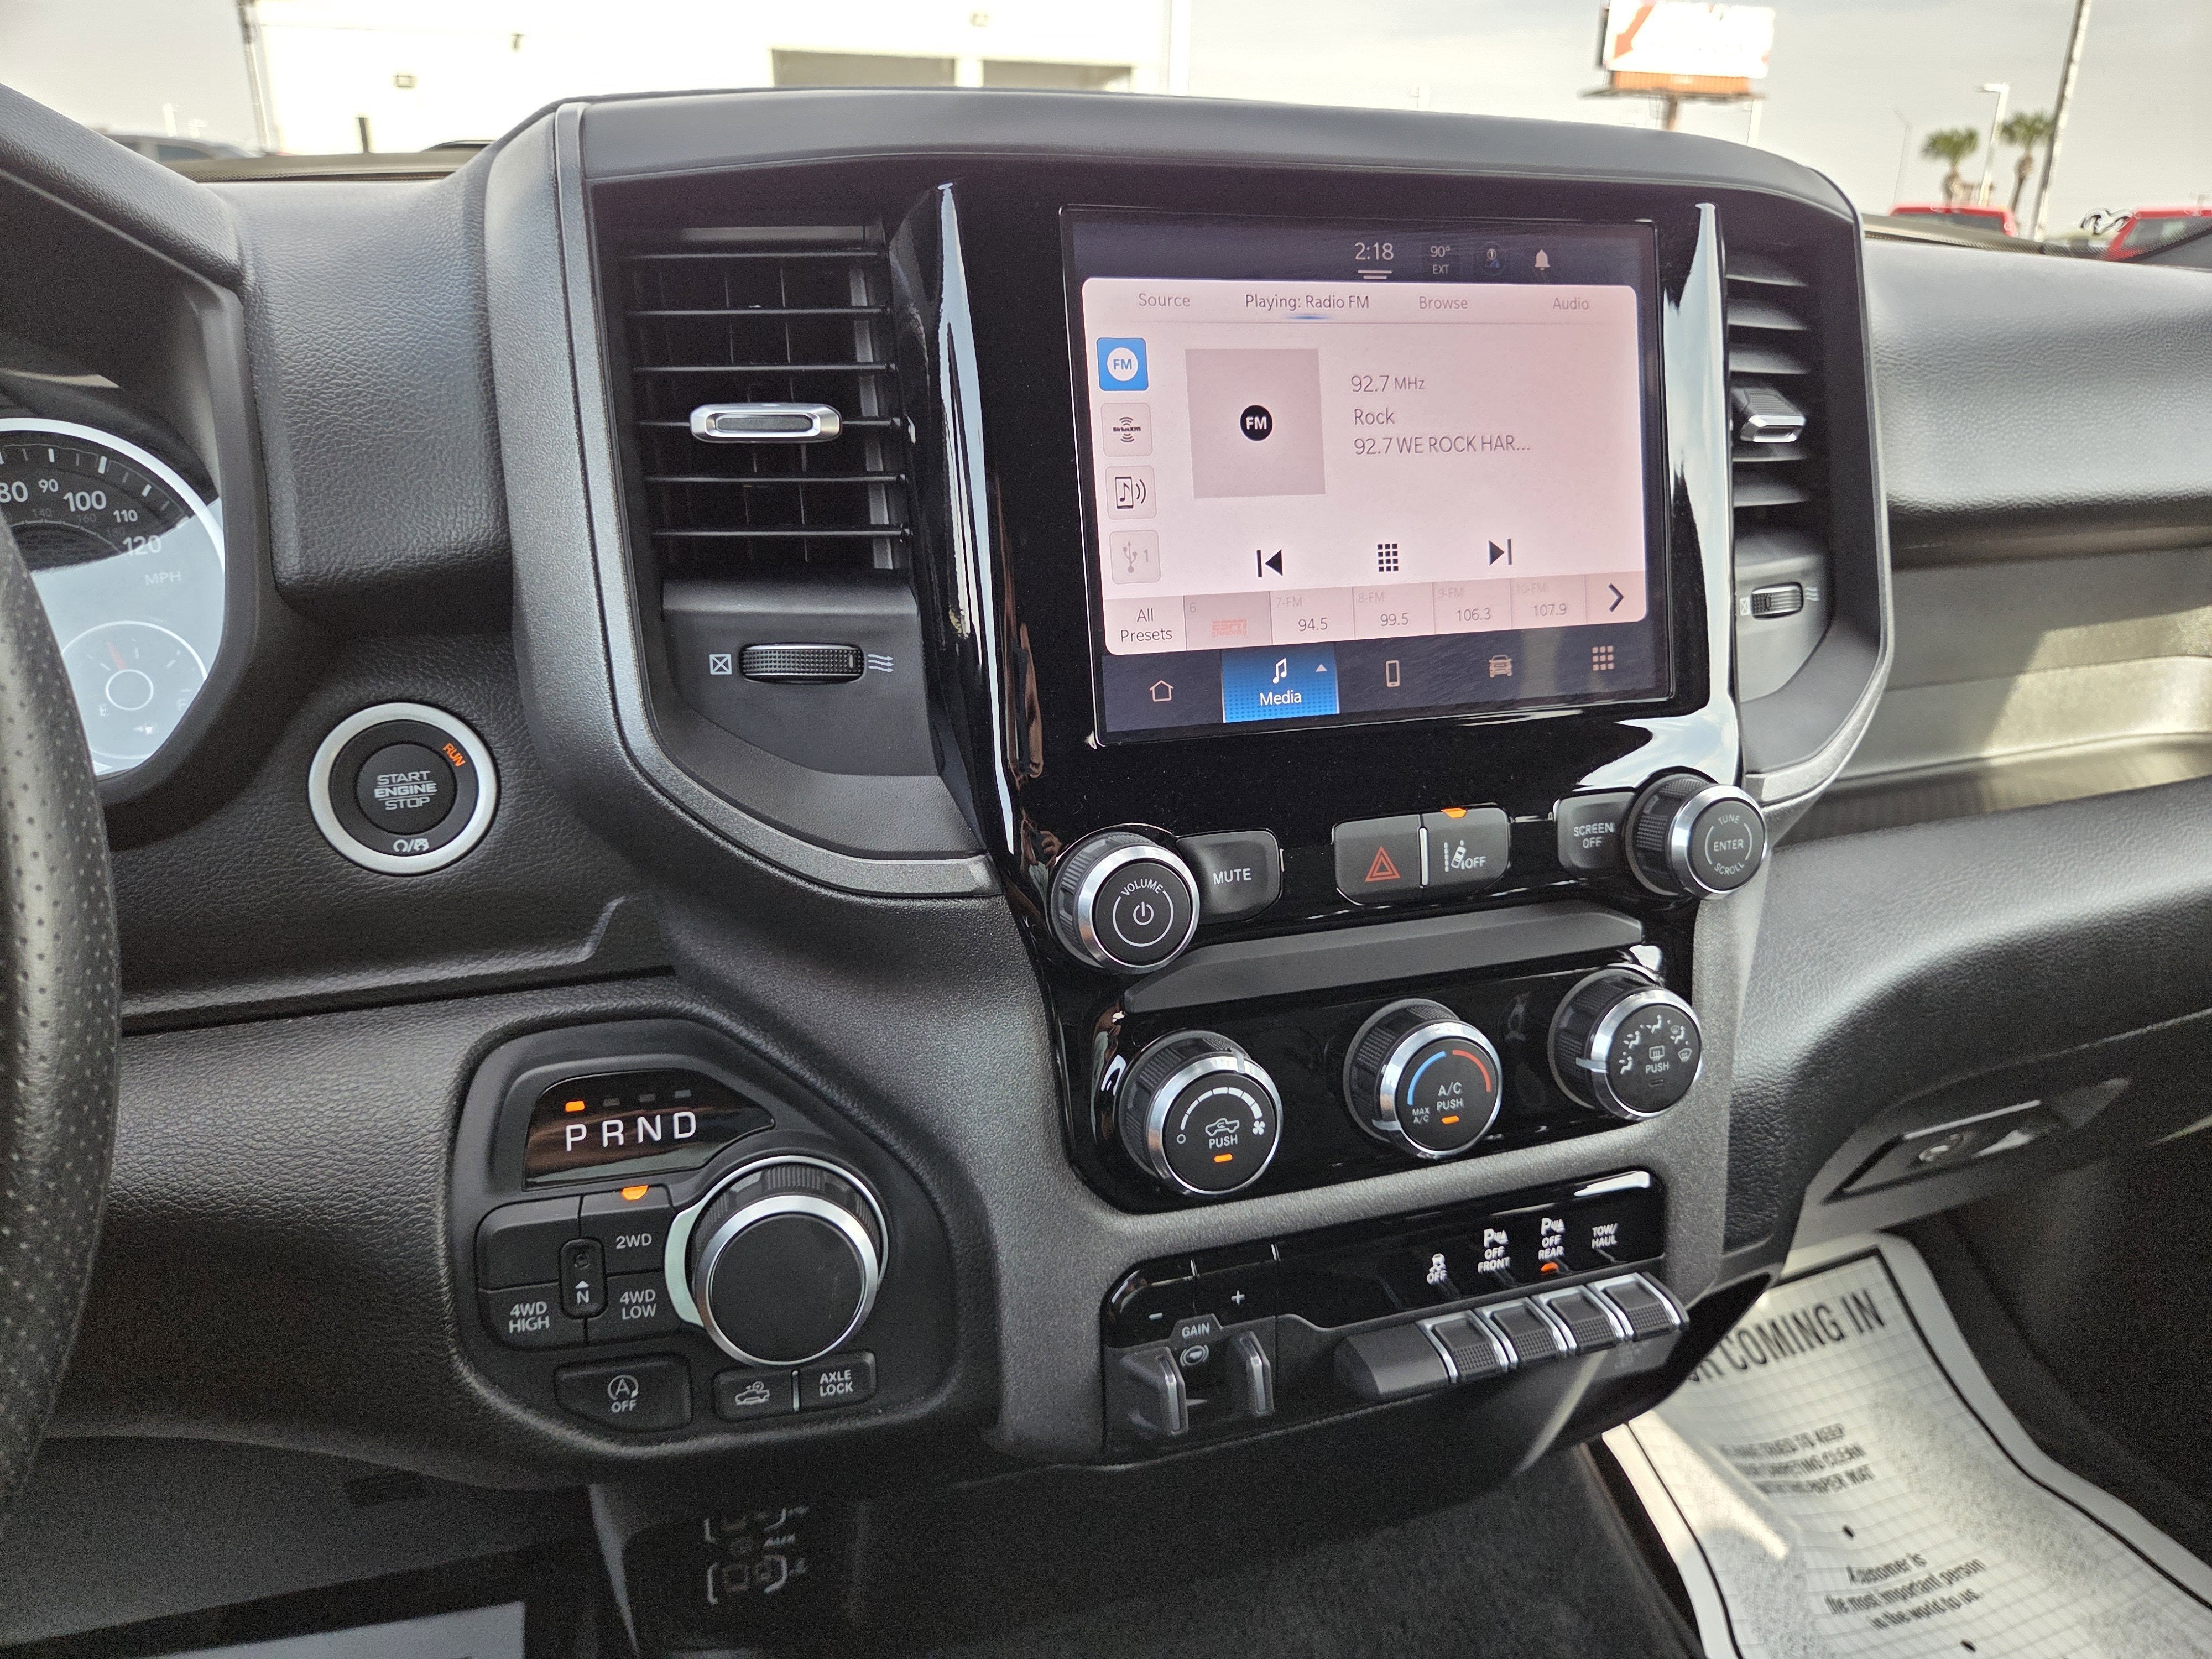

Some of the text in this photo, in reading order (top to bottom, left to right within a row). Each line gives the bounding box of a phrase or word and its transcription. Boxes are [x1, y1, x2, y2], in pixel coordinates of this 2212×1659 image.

[1354, 242, 1394, 260] 2:18
[1433, 264, 1449, 275] EXT
[1138, 293, 1191, 307] Source
[1245, 294, 1369, 311] Playing: Radio FM
[1419, 295, 1468, 310] Browse
[1552, 296, 1590, 310] Audio
[1113, 358, 1132, 371] FM
[1350, 375, 1426, 393] 92.7 MHz
[1246, 416, 1267, 430] FM
[1354, 407, 1395, 426] Rock
[1354, 437, 1392, 455] 92.7
[1396, 436, 1423, 454] WE
[1428, 435, 1477, 453] ROCK
[38, 478, 59, 493] 90
[63, 490, 107, 513] 100
[112, 509, 138, 523] 110
[122, 535, 162, 556] 120
[144, 570, 181, 586] MPH
[1275, 596, 1303, 608] 7-FM
[1357, 591, 1385, 603] 8-FM
[1136, 608, 1154, 623] All
[1457, 607, 1491, 622] 106.3
[1533, 603, 1567, 617] 107.9
[1298, 617, 1328, 632] 94.5
[1380, 612, 1409, 627] 99.5
[1120, 627, 1173, 643] Presets
[1259, 689, 1302, 707] Media
[442, 742, 466, 768] RUN
[377, 770, 431, 786] START
[374, 782, 437, 799] ENGINE
[385, 796, 431, 811] STOP
[1717, 813, 1741, 826] TUNE
[1573, 821, 1614, 837] SCREEN
[1582, 836, 1603, 849] OFF
[1713, 838, 1745, 852] ENTER
[1465, 855, 1487, 869] OFF
[1714, 862, 1745, 876] SCROLL
[1213, 868, 1252, 886] MUTE
[1120, 878, 1164, 898] VOLUME
[1645, 1061, 1670, 1074] PUSH
[1438, 1081, 1463, 1097] A/C
[1412, 1107, 1430, 1117] MAX
[1436, 1098, 1464, 1112] PUSH
[1413, 1115, 1430, 1124] A/C
[566, 1110, 697, 1151] P R N D
[1209, 1134, 1238, 1150] PUSH
[1592, 1222, 1619, 1238] TOW/
[615, 1233, 653, 1250] 2WD
[1541, 1234, 1562, 1249] OFF
[1592, 1234, 1618, 1249] HAUL
[1484, 1246, 1505, 1261] OFF
[1538, 1245, 1565, 1261] REAR
[1478, 1256, 1511, 1274] FRONT
[1426, 1269, 1448, 1285] OFF
[576, 1290, 590, 1304] N
[619, 1288, 656, 1305] 4WD
[509, 1301, 548, 1318] 4WD
[622, 1303, 657, 1321] LOW
[509, 1315, 550, 1334] HIGH
[1181, 1322, 1211, 1340] GAIN
[1718, 1302, 1846, 1370] COMING
[1839, 1287, 1885, 1334] IN
[820, 1369, 852, 1385] AXLE
[819, 1381, 854, 1398] LOCK
[611, 1399, 637, 1413] OFF
[1906, 1552, 1927, 1568] is
[1939, 1558, 1987, 1588] person
[1939, 1595, 1963, 1611] to
